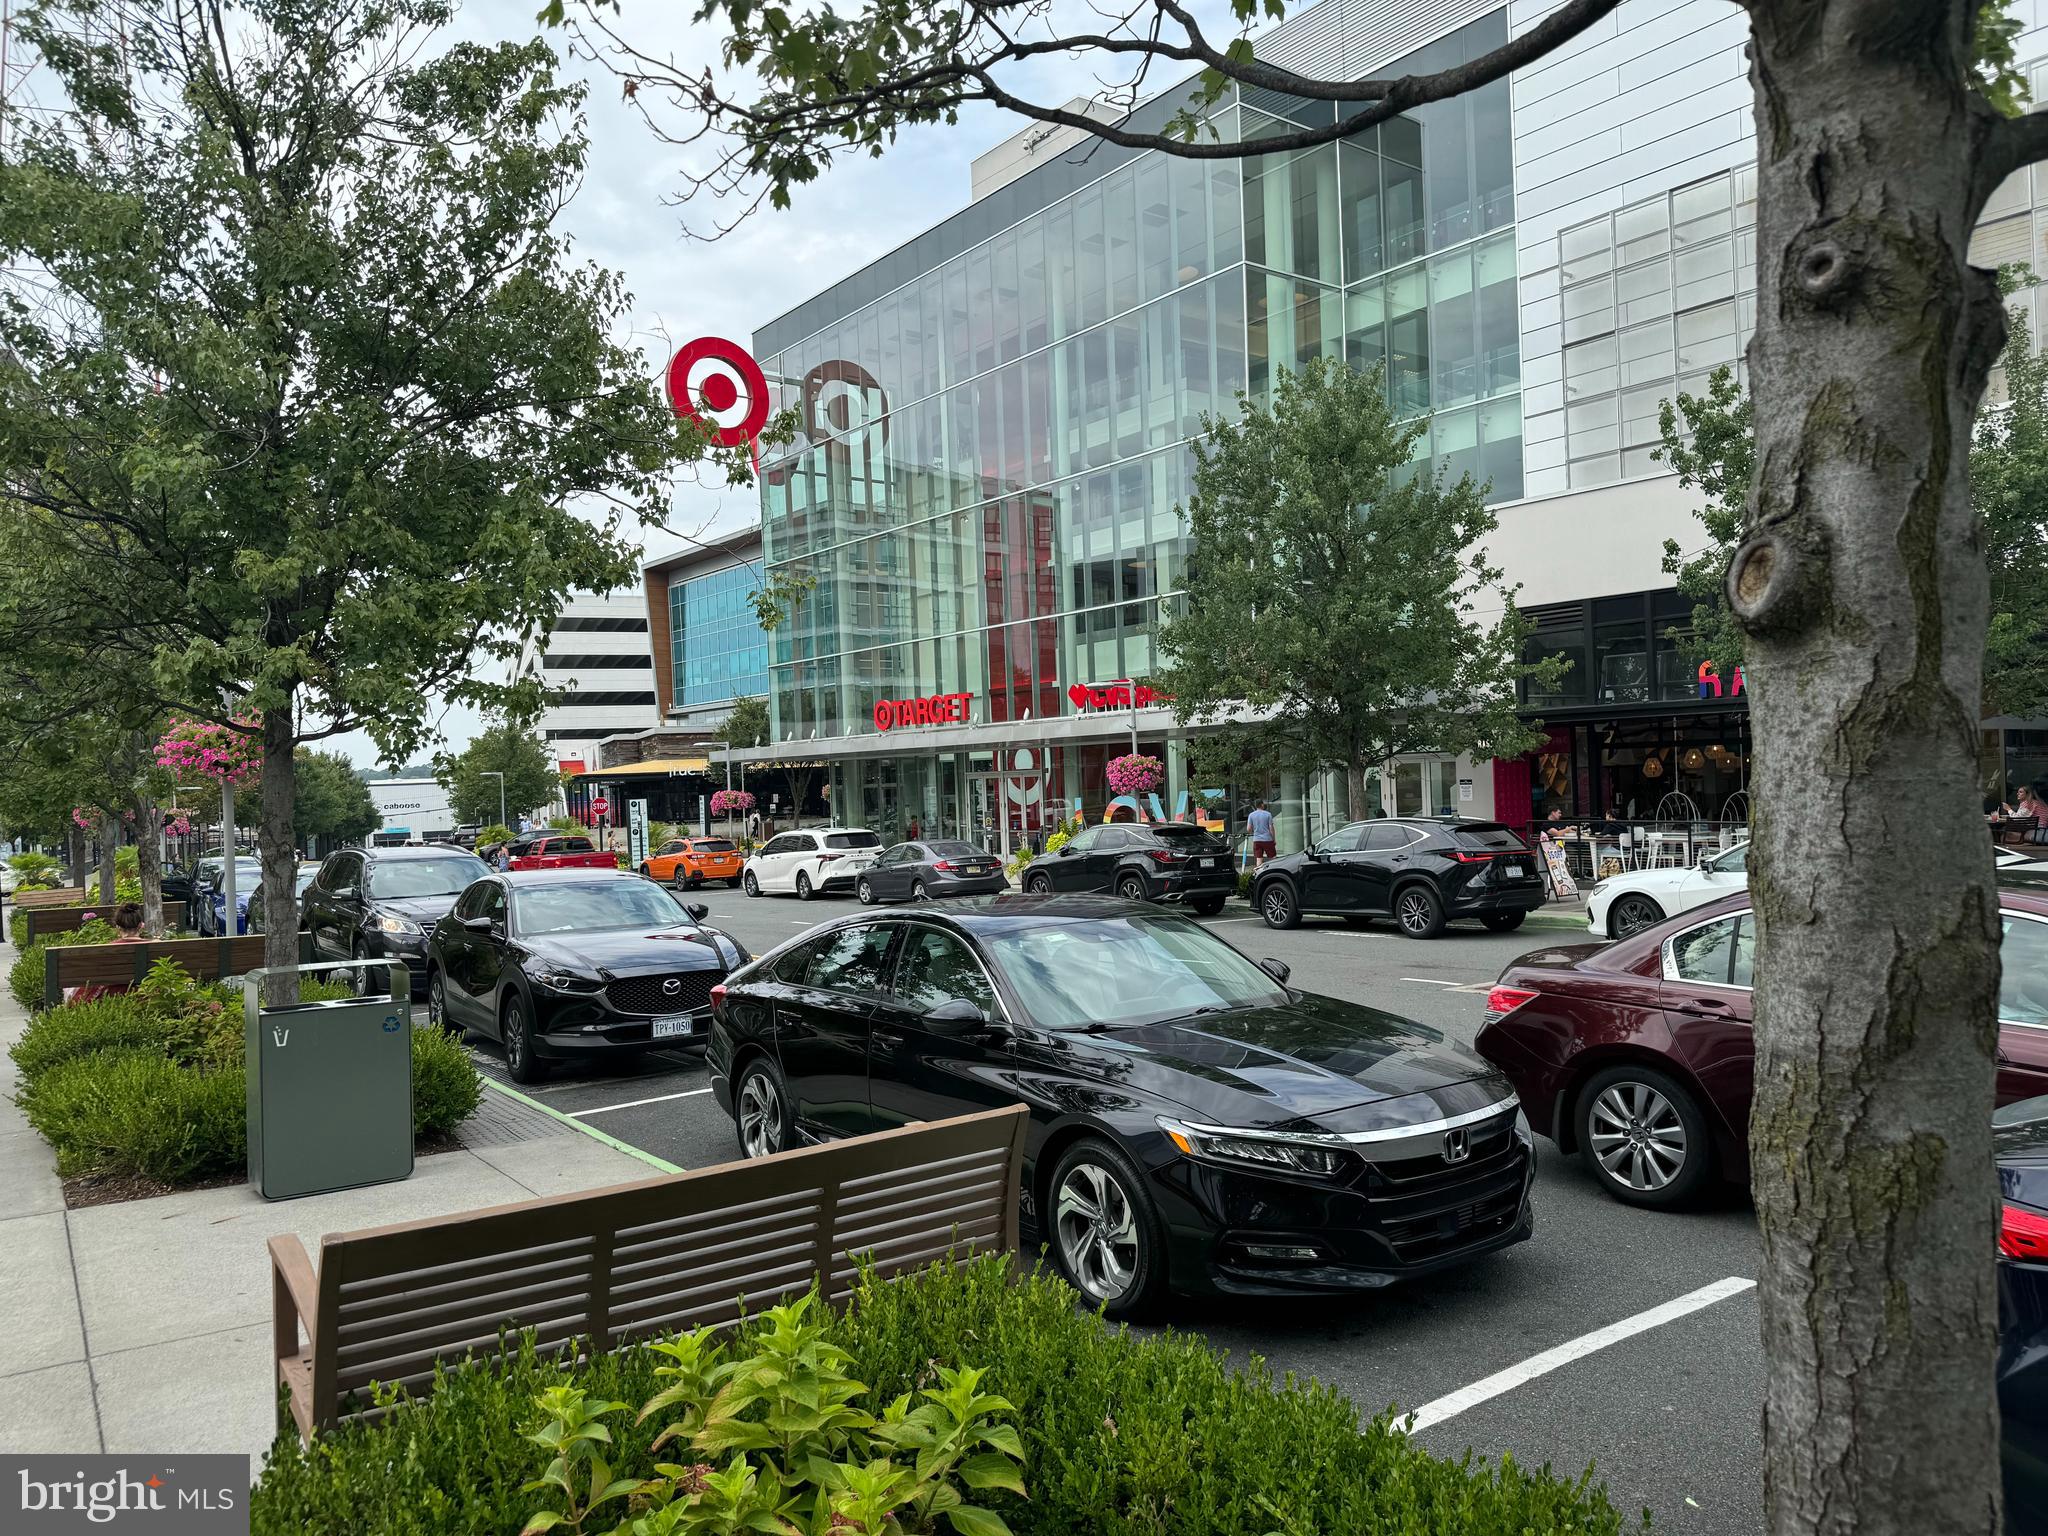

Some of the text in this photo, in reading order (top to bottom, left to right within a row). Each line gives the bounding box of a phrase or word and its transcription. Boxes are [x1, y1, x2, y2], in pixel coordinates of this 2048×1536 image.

[891, 692, 974, 727] TARGET
[384, 802, 421, 810] caboose
[592, 801, 608, 811] STOP
